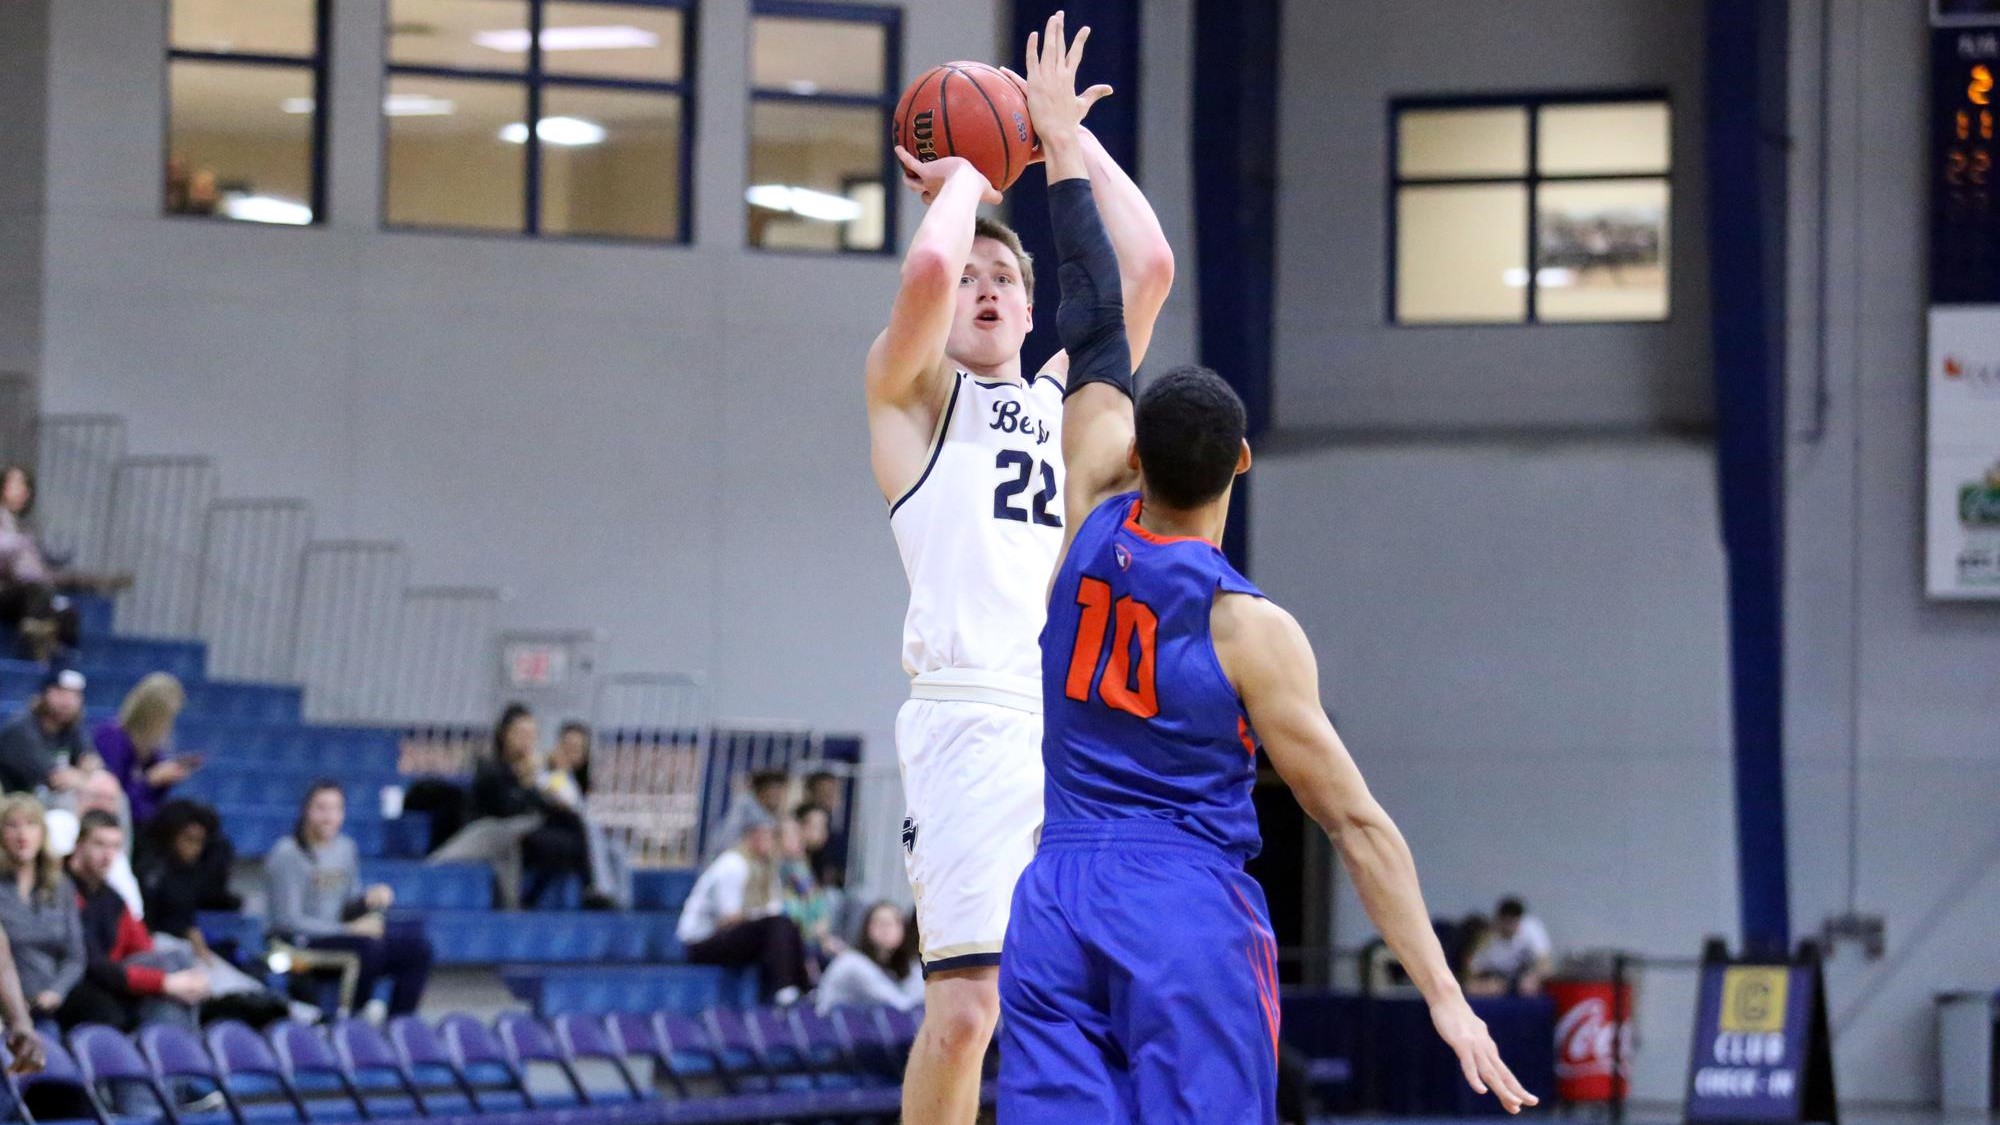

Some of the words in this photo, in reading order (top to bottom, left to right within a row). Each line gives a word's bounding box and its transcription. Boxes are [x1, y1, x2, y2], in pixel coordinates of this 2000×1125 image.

[1967, 64, 1994, 104] 2
[912, 108, 939, 164] Wil
[993, 449, 1063, 527] 22
[1063, 575, 1161, 719] 10
